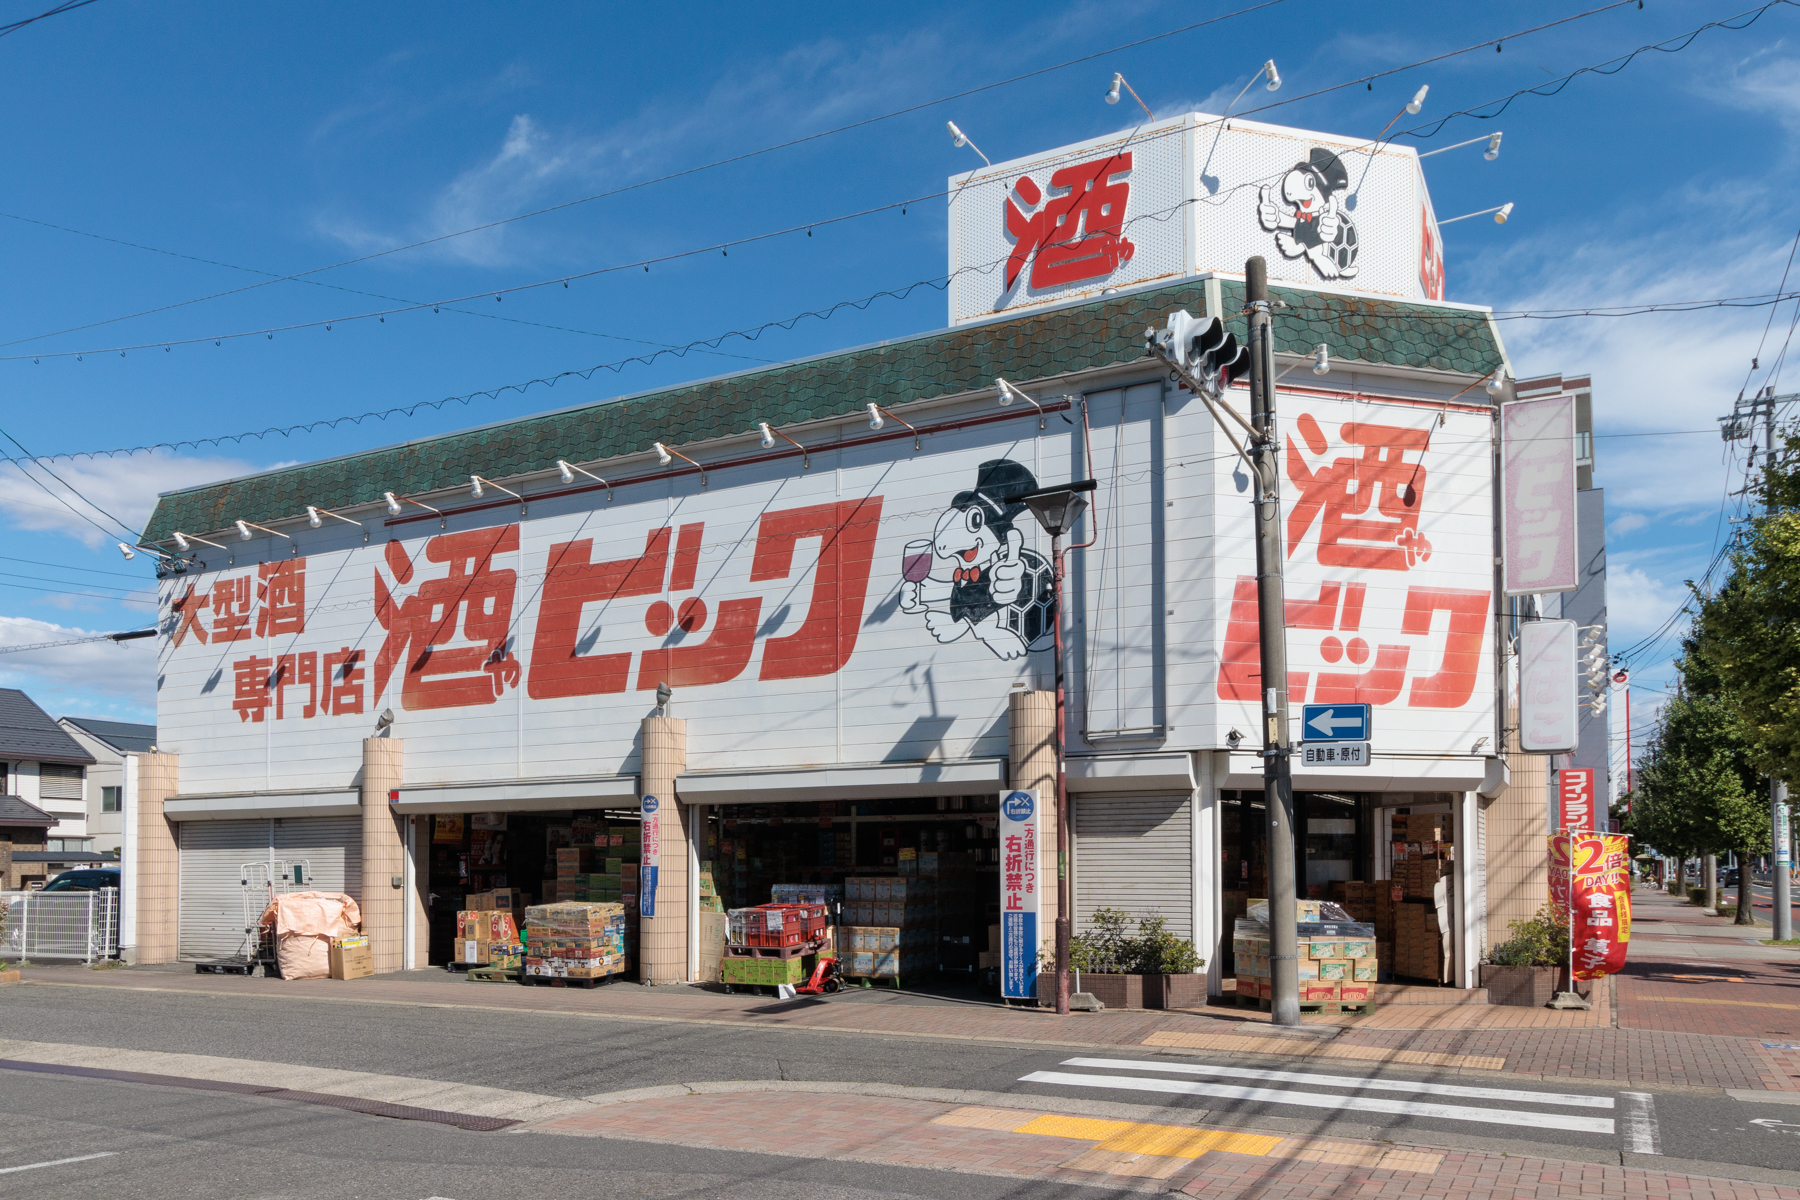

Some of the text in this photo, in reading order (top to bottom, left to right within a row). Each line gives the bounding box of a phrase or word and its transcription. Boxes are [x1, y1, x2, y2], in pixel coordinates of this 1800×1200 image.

[172, 557, 307, 649] 大型酒
[232, 646, 365, 723] 専門店
[1525, 628, 1570, 744] たばこ
[1306, 747, 1360, 762] 自動車・原付
[643, 820, 652, 866] 右折禁止
[1005, 834, 1023, 911] 右折禁止
[1024, 823, 1035, 893] 一方通行につき
[1580, 892, 1613, 969] 食品・菓子
[1618, 895, 1629, 934] 会員様限定
